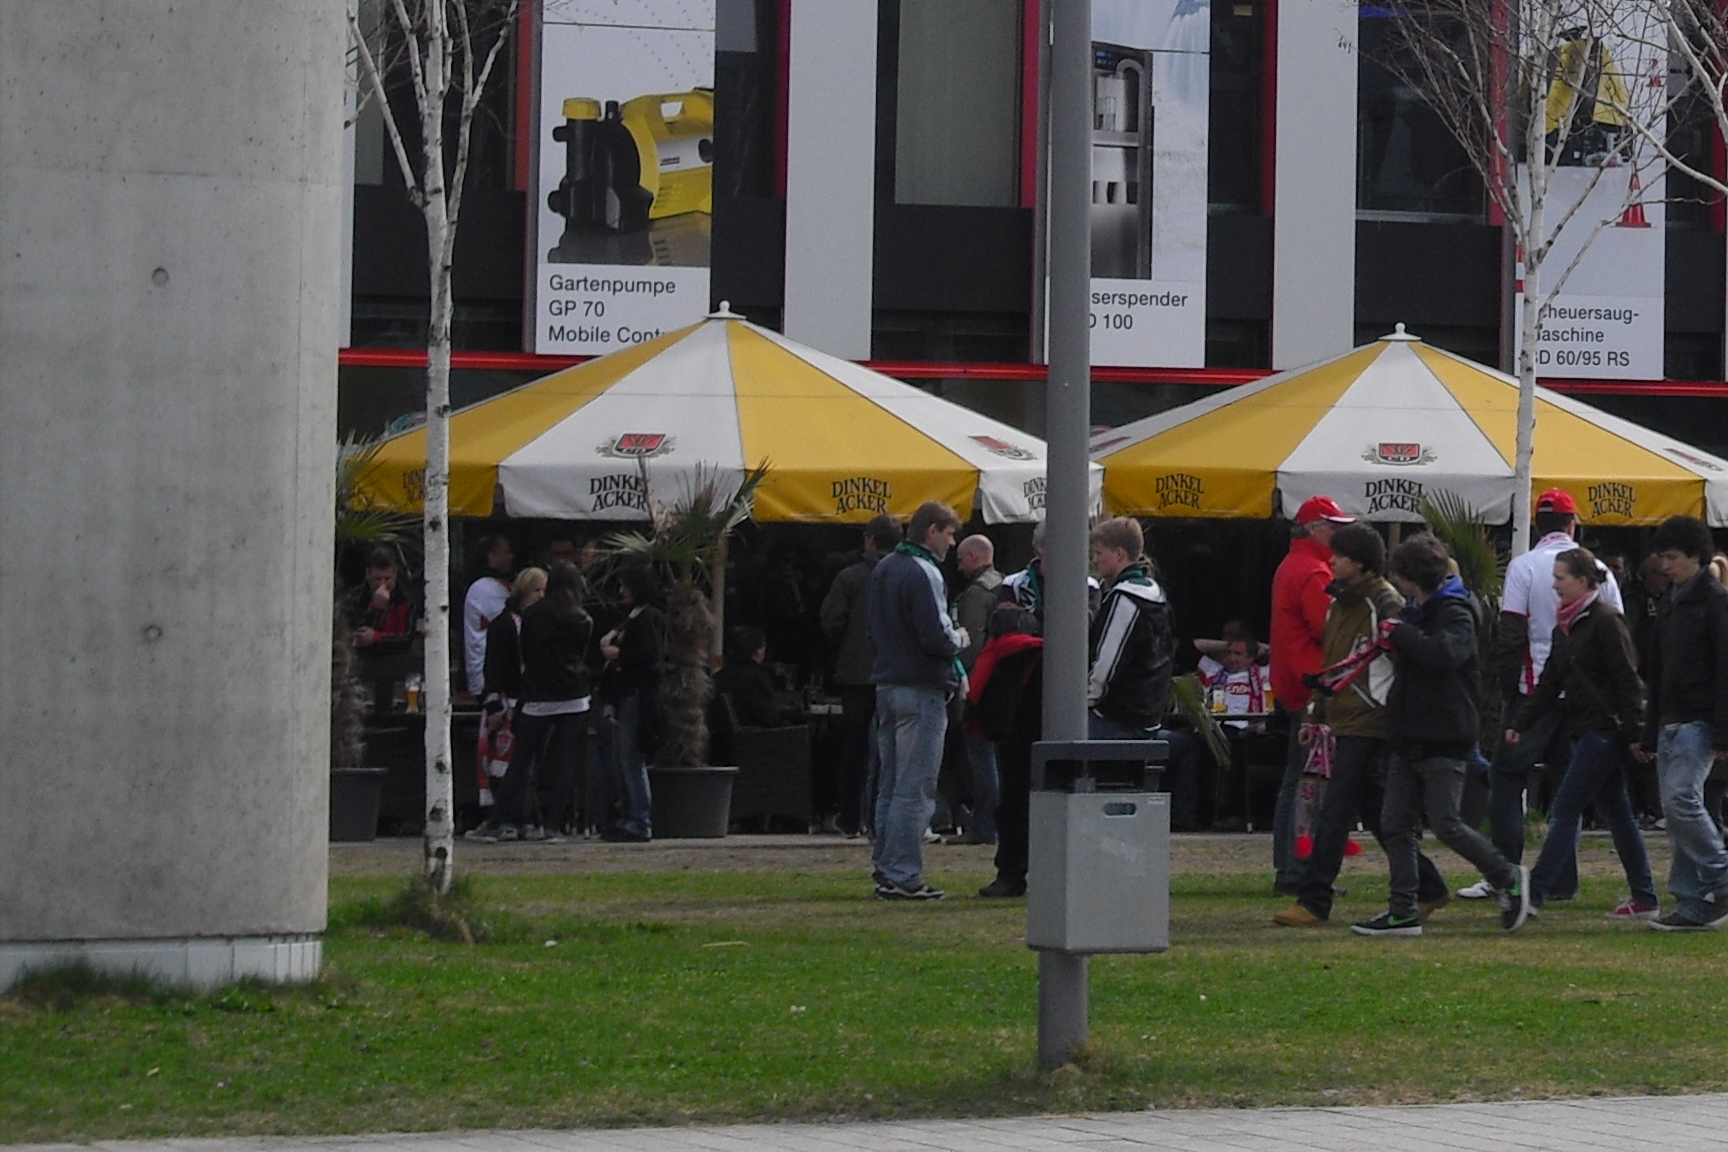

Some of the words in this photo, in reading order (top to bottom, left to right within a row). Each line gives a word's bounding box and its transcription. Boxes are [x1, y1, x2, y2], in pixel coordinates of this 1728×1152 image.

[549, 274, 676, 297] Gartenpumpe
[548, 299, 577, 317] GP
[582, 301, 605, 318] 70
[1091, 291, 1188, 308] serspender
[1103, 313, 1133, 330] 100
[548, 325, 611, 343] Mobile
[617, 326, 665, 343] Cont
[1537, 327, 1605, 343] aschine
[1556, 350, 1602, 366] 60/95
[1607, 351, 1630, 367] RS
[832, 476, 892, 500] DINKEL
[1155, 473, 1204, 495] DINKEL
[1365, 477, 1427, 499] DINKEL
[1587, 481, 1637, 503] DINKEL
[836, 494, 887, 515] ACKER
[1158, 489, 1200, 510] ACKER
[1367, 494, 1423, 515] ACKER
[1591, 498, 1633, 519] ACKER
